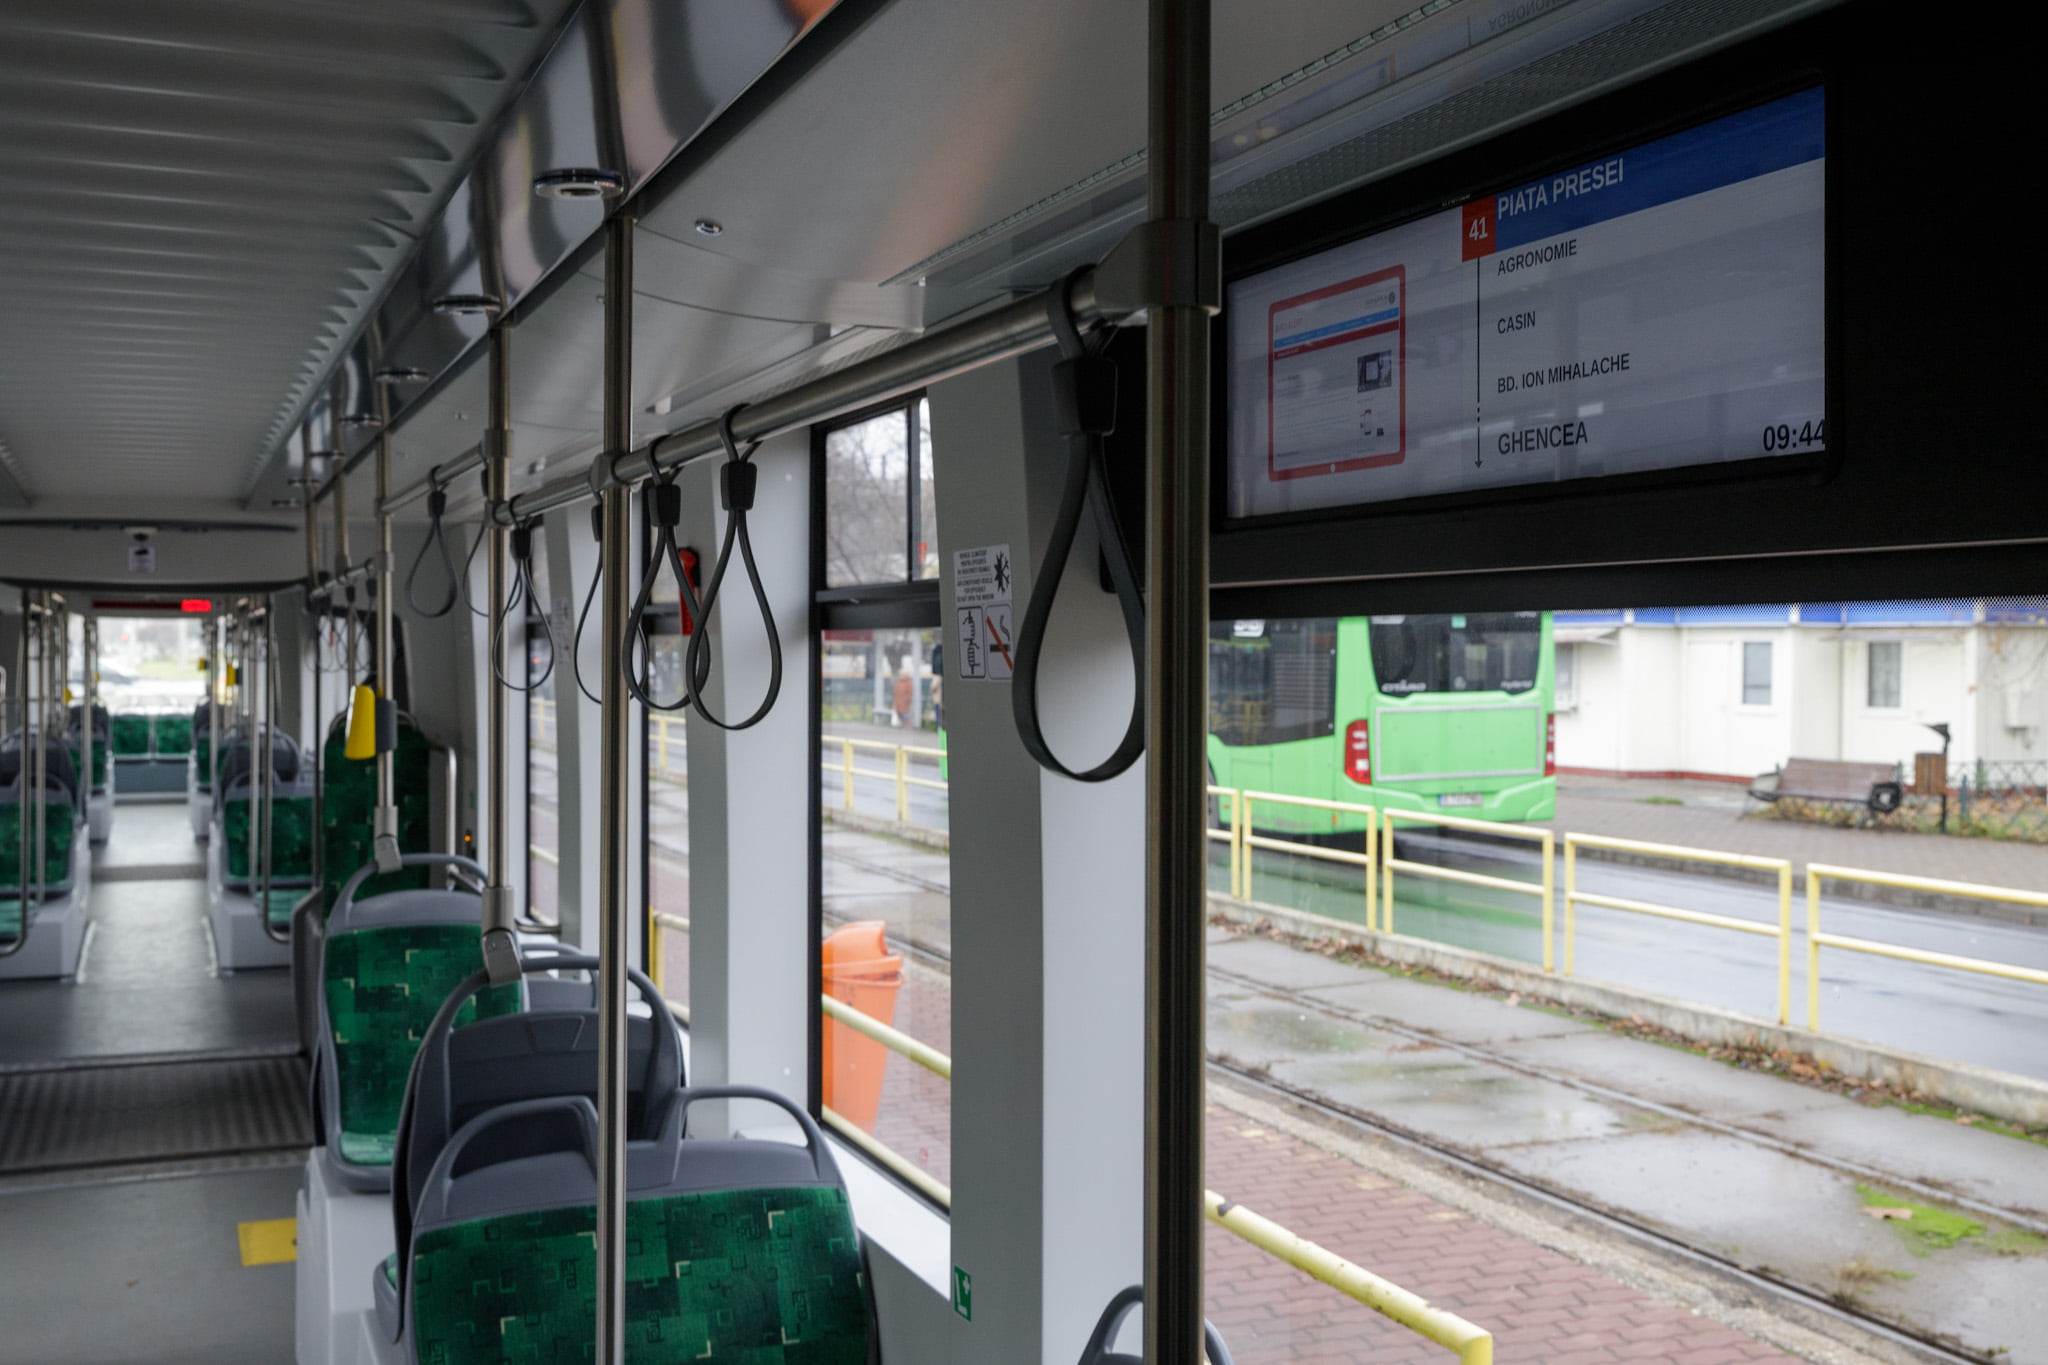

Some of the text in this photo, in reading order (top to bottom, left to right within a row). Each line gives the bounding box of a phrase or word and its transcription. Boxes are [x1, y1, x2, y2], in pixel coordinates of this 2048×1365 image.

[1498, 184, 1547, 220] PIATA
[1553, 158, 1624, 203] PRESEI
[1468, 216, 1489, 241] 41
[1497, 239, 1577, 276] AGRONOMIE
[1497, 311, 1536, 334] CASIN
[1498, 353, 1631, 394] BD. ION MIHALACHE
[1498, 421, 1588, 455] GHENCEA
[1763, 419, 1825, 452] 09:44
